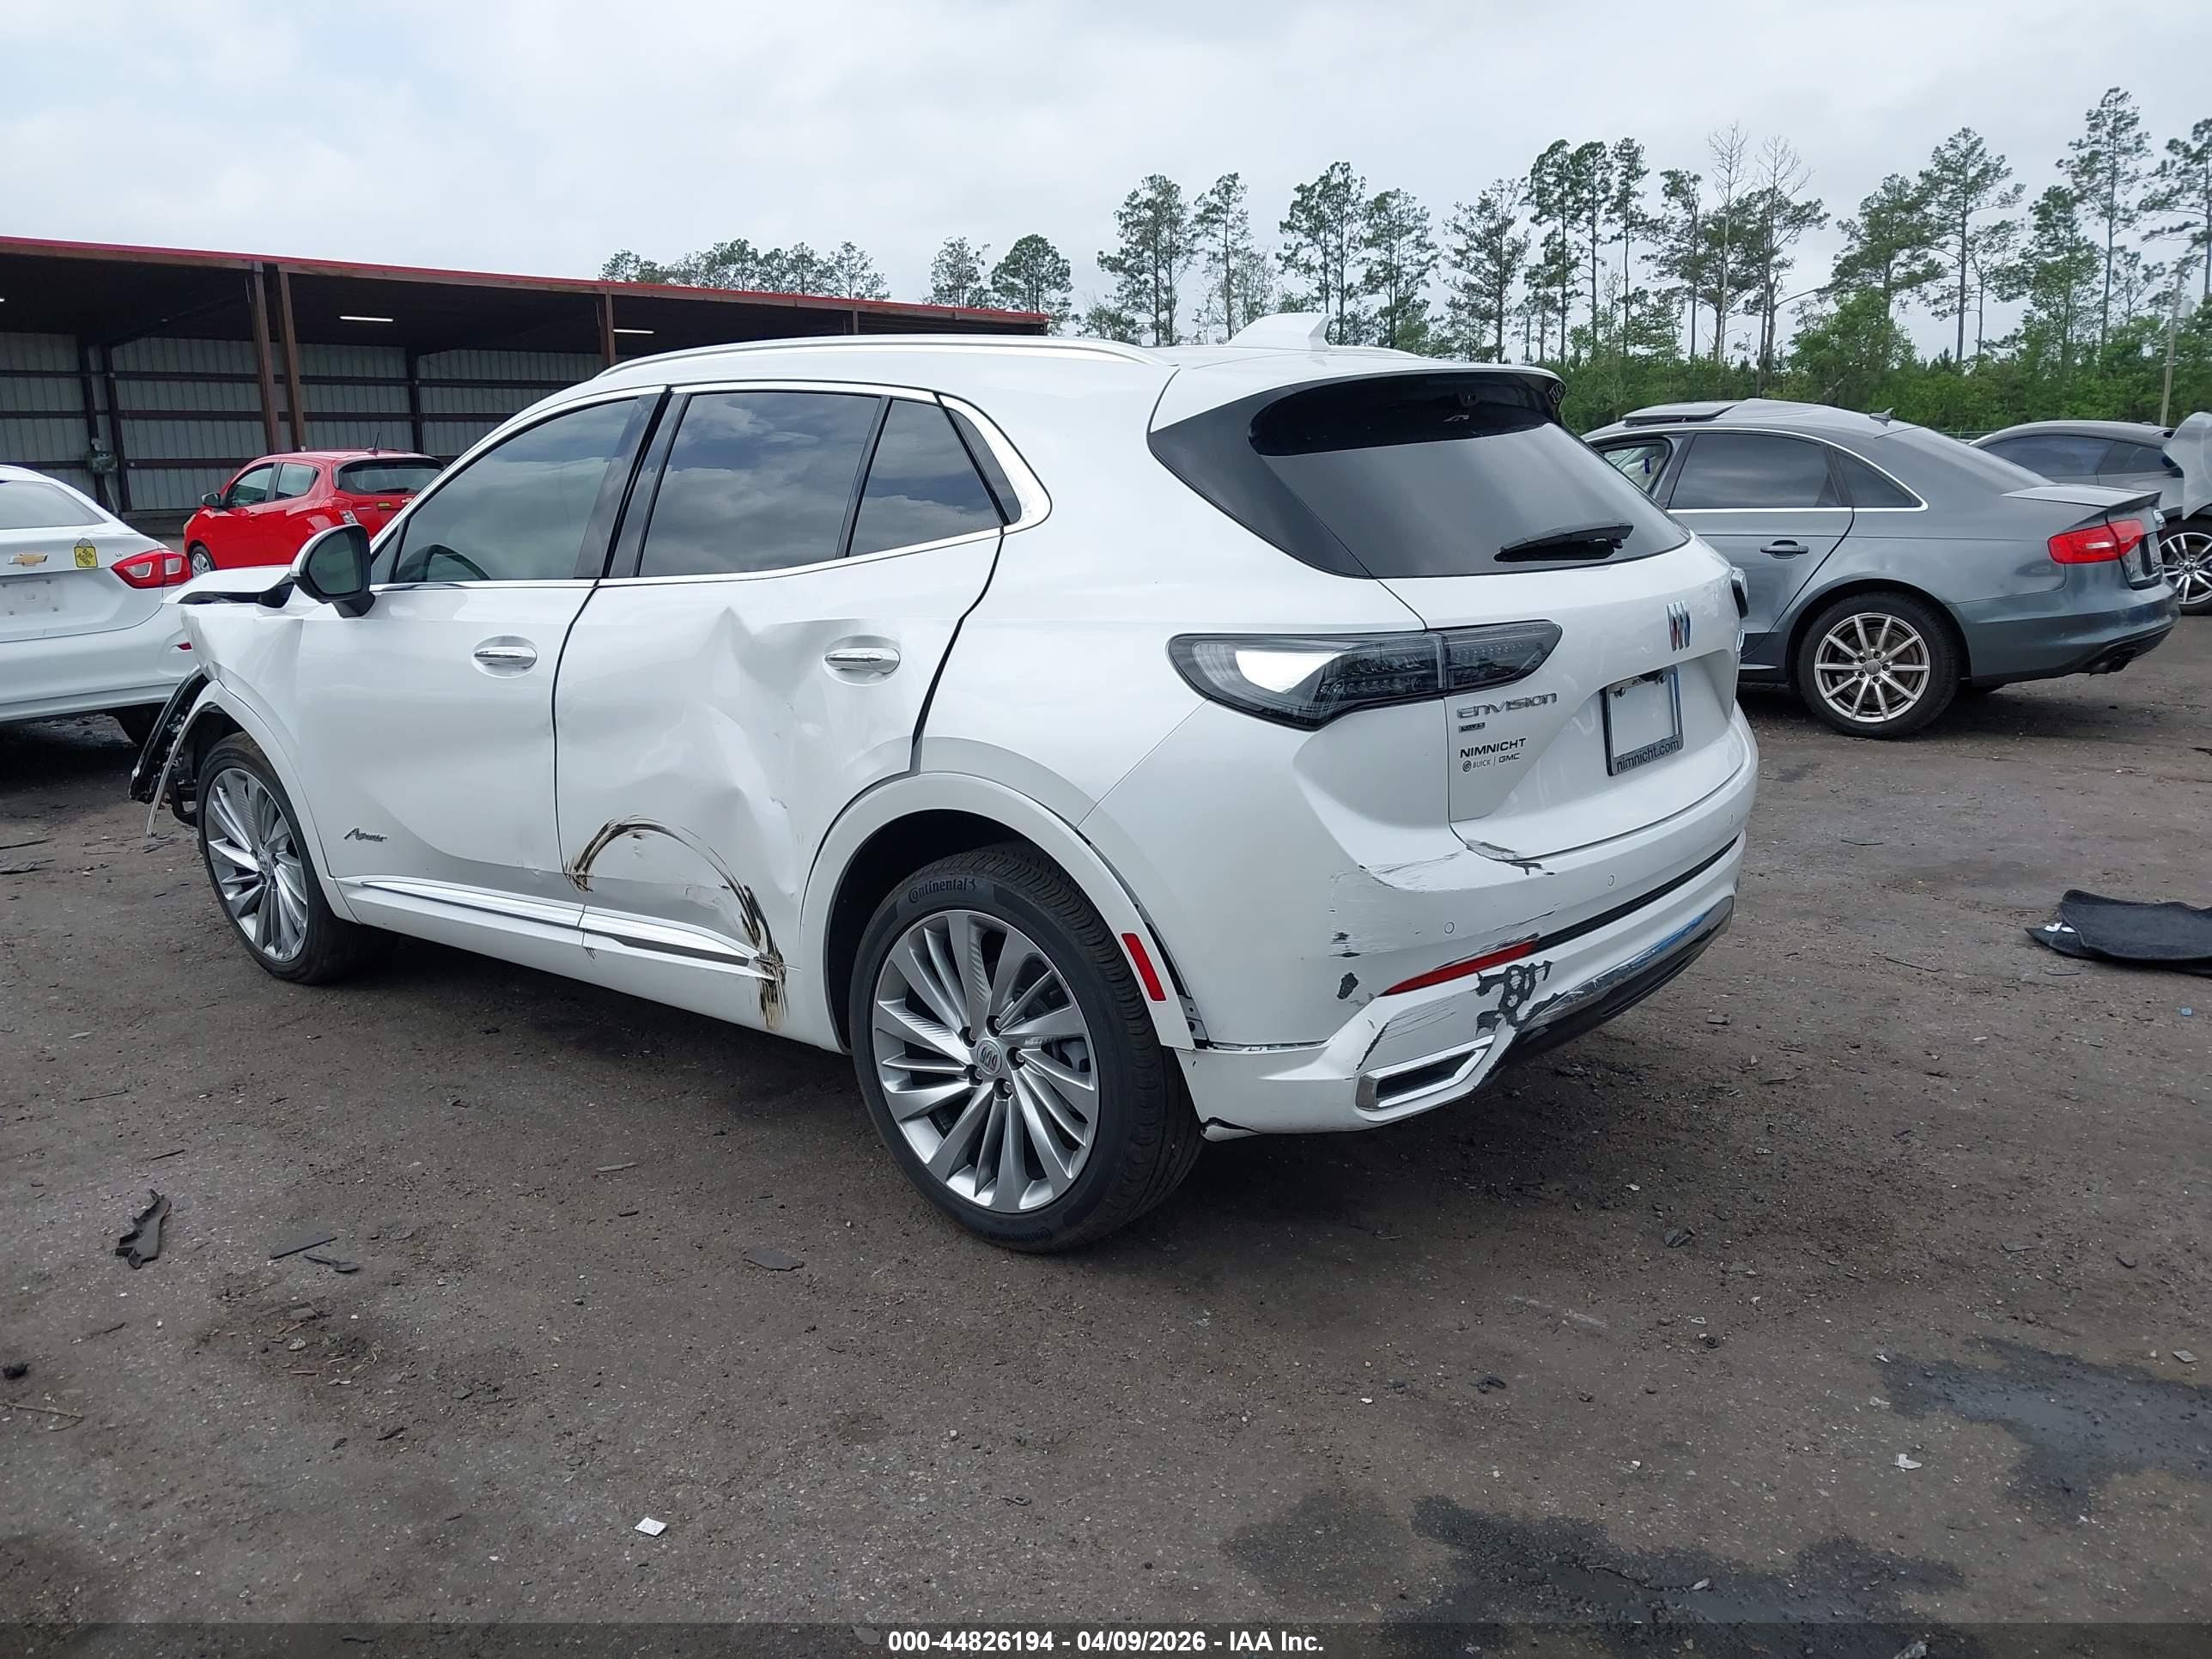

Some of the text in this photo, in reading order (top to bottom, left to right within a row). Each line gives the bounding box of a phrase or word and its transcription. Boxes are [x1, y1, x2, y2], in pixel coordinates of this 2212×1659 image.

[1460, 738, 1527, 758] NIMNICHT
[1616, 740, 1680, 773] nimnicht.com
[1473, 752, 1521, 769] BUICK GMC
[908, 878, 968, 903] Continental
